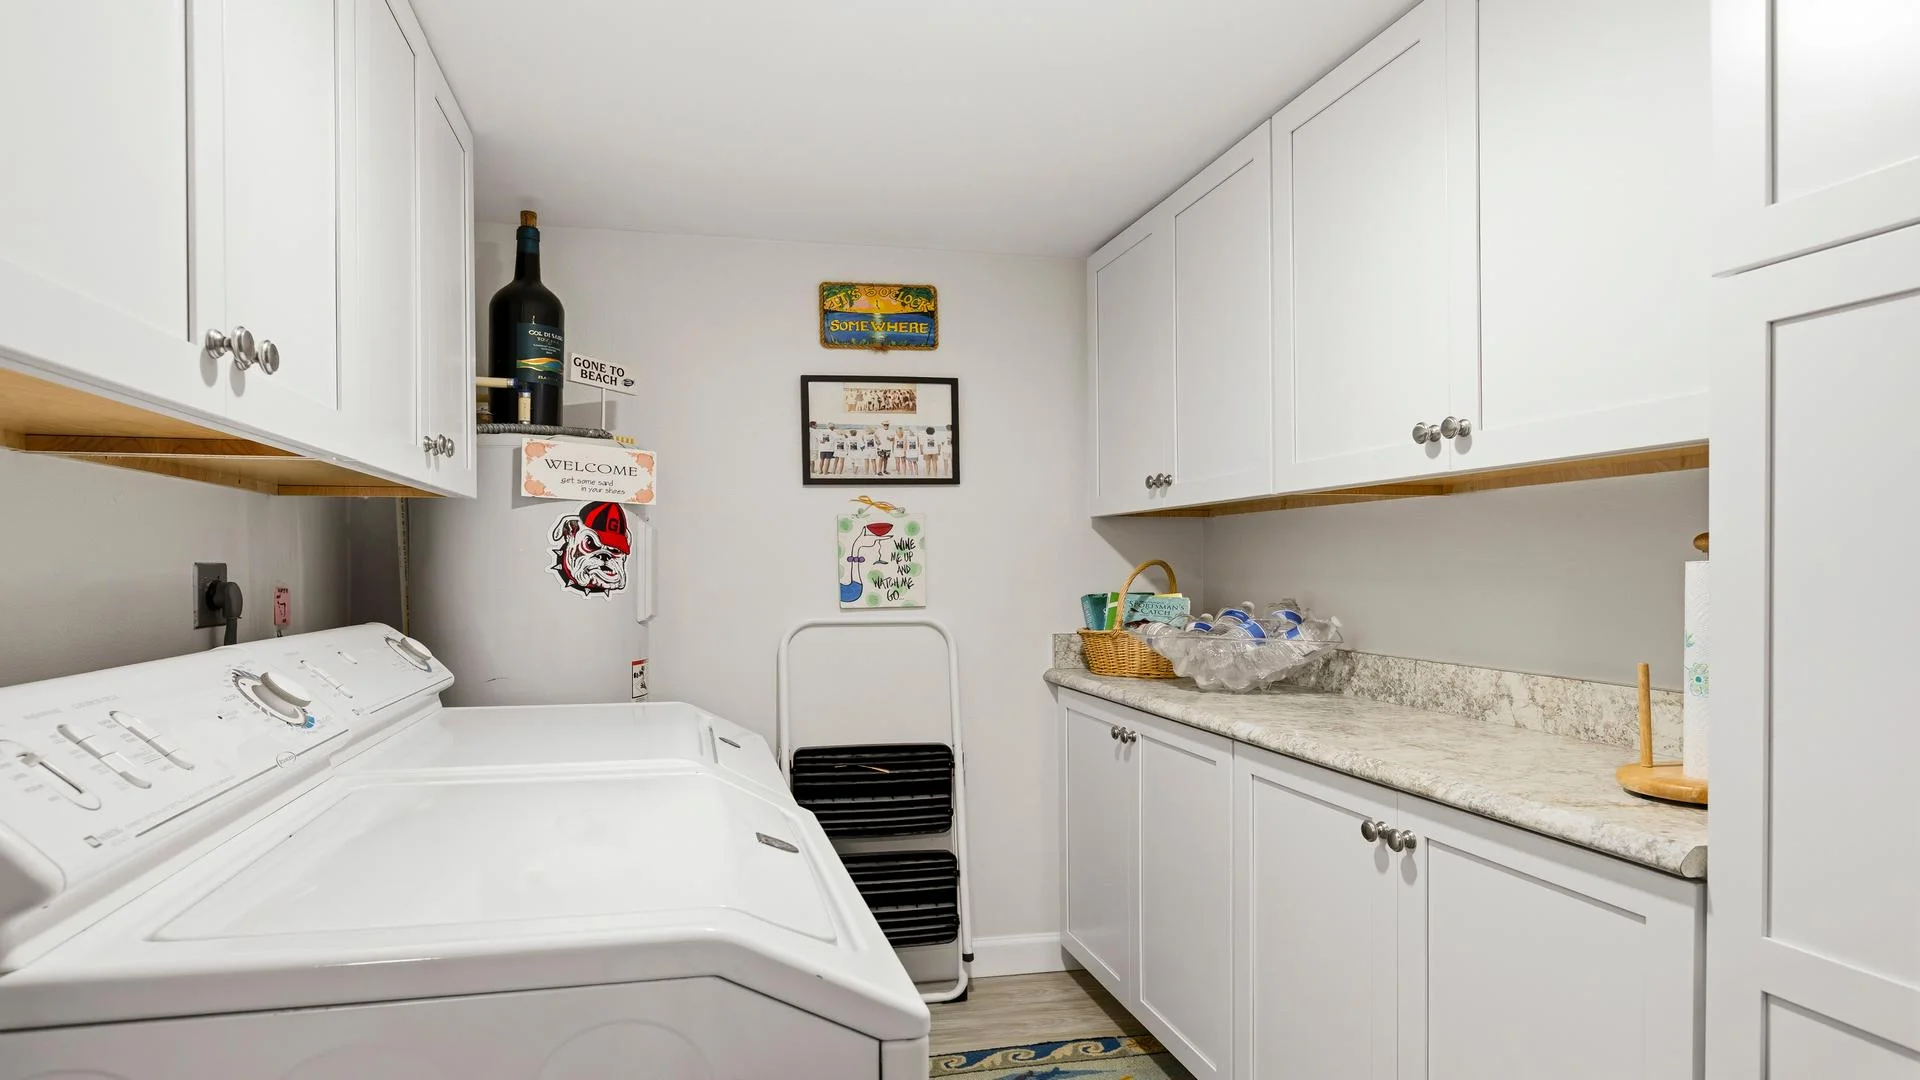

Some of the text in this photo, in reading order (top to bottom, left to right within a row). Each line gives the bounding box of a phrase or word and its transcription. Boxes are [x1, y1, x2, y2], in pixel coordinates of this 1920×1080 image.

[864, 287, 878, 297] 5
[829, 319, 929, 334] SOMEWHERE
[573, 356, 625, 378] GONE TO
[580, 369, 618, 386] BEACH
[544, 458, 639, 477] WELCOME
[577, 478, 596, 487] some
[598, 479, 614, 487] sand
[587, 487, 602, 495] your
[605, 486, 626, 495] shoes
[608, 518, 618, 532] G
[893, 537, 917, 551] WINE
[890, 551, 914, 565] ME UP
[896, 565, 911, 576] AND
[872, 575, 914, 590] WATCH ME
[1128, 599, 1185, 611] SPORTSMAN'S
[1140, 608, 1171, 616] CATCH
